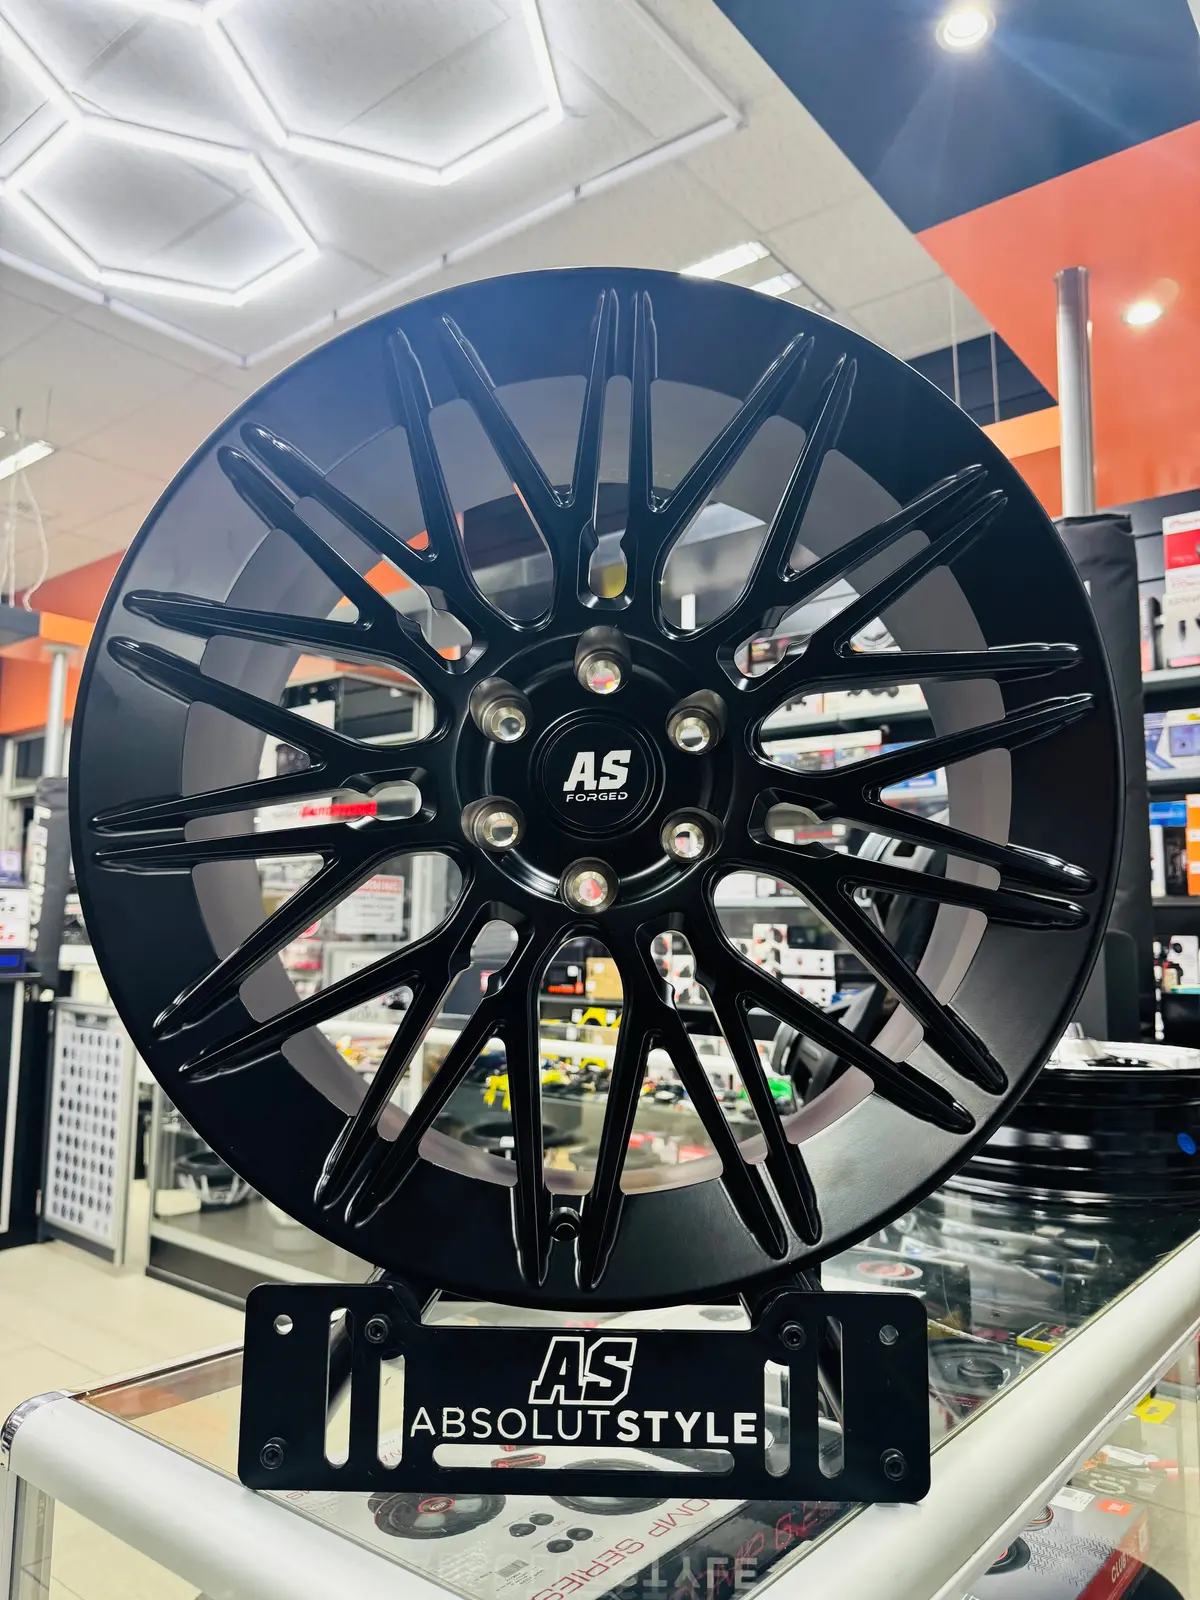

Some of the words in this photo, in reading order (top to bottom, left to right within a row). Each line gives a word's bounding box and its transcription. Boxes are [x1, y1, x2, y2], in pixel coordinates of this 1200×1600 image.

[563, 750, 632, 791] AS
[565, 791, 629, 803] FORGED
[528, 1336, 638, 1406] AS
[410, 1406, 758, 1444] ABSOLUTSTYLE
[648, 1498, 710, 1537] OMP
[531, 1538, 645, 1600] SERIES
